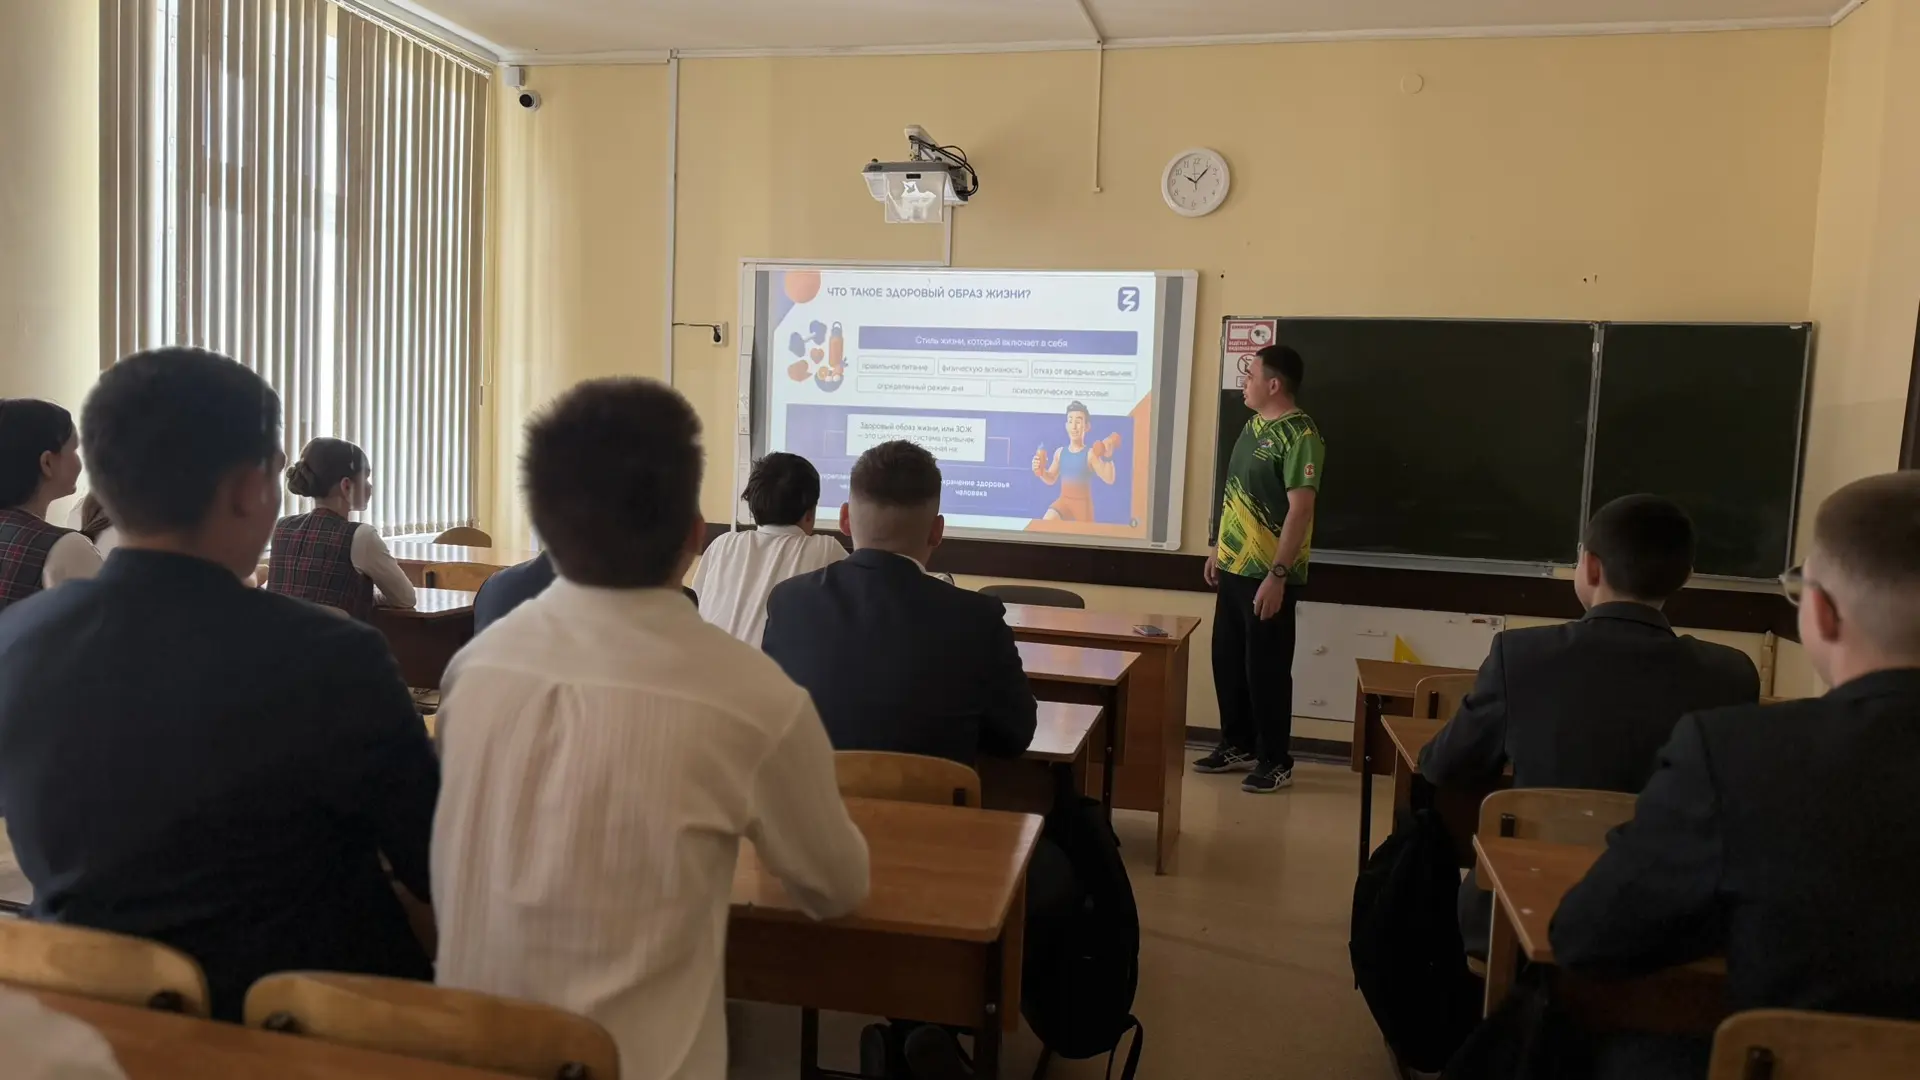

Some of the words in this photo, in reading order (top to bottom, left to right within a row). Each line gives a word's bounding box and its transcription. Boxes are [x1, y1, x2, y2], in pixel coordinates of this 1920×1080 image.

[827, 288, 847, 296] ЧТО
[851, 288, 882, 297] ТАКОЕ
[886, 287, 945, 298] ЗДОРОВЫЙ
[948, 288, 982, 298] ОБРАЗ
[985, 289, 1031, 299] ЖИЗНИ?
[915, 336, 938, 344] Стиль
[940, 338, 965, 346] жизни,
[967, 338, 1000, 347] который
[1002, 339, 1040, 347] включает
[1047, 338, 1068, 347] себя
[860, 422, 894, 431] Здоровый
[896, 423, 915, 431] образ
[976, 480, 1010, 488] здоровья
